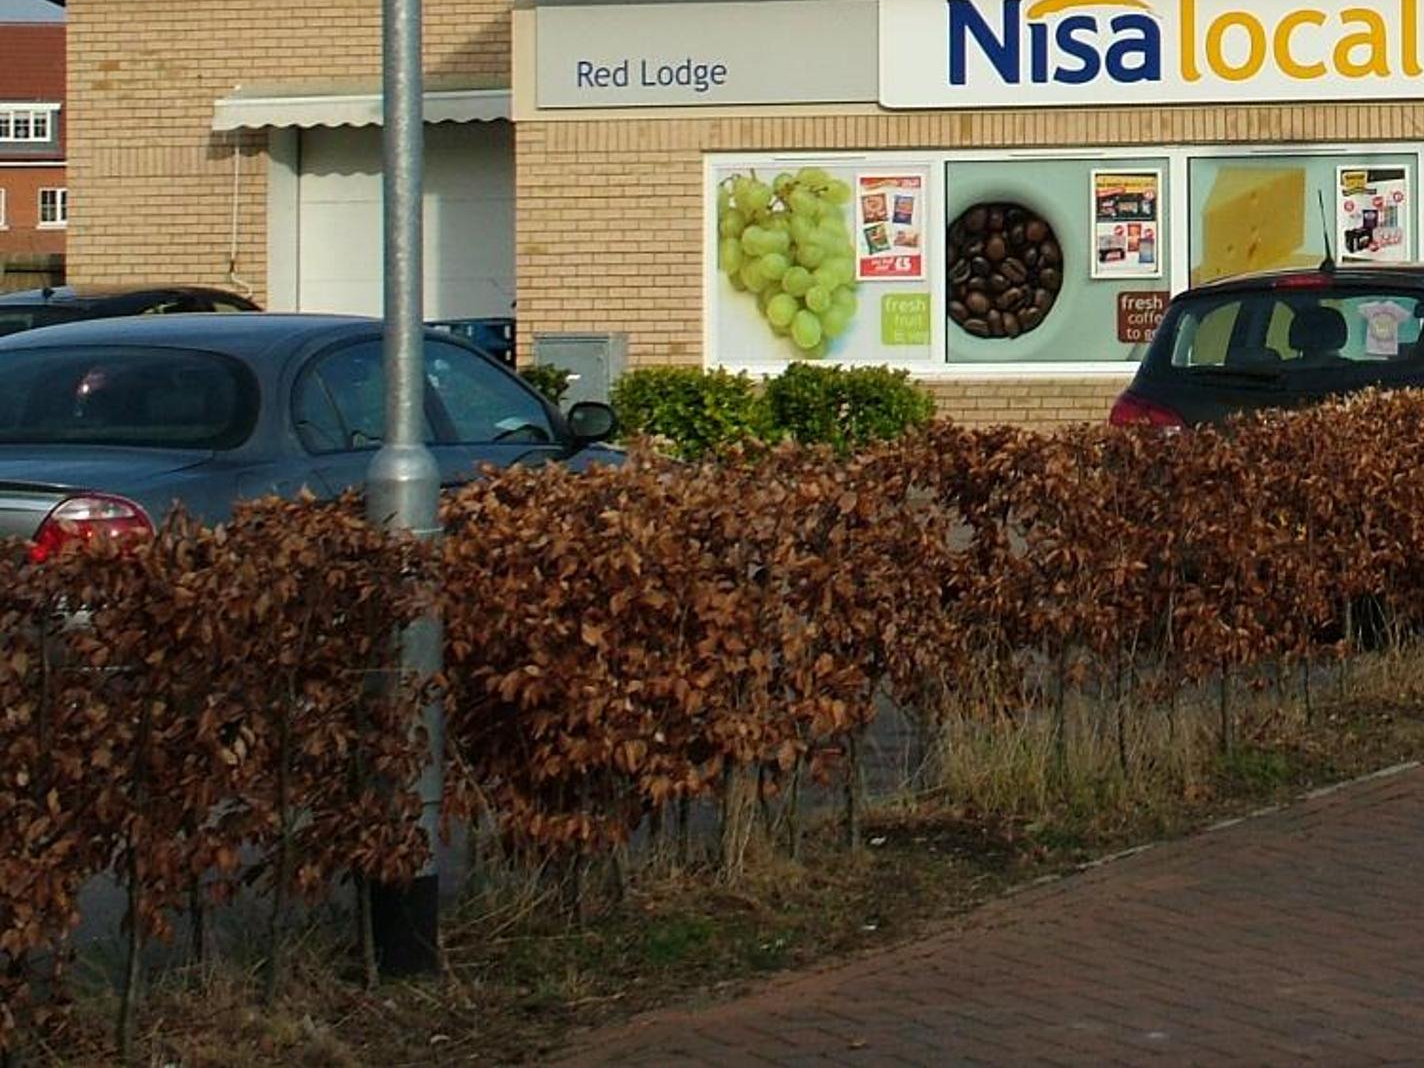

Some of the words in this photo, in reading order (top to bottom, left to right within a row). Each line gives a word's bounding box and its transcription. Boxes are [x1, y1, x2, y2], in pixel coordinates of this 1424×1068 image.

[577, 60, 628, 87] Red
[641, 59, 727, 92] Lodge
[885, 297, 927, 313] fresh
[1121, 294, 1163, 310] fresh
[1127, 311, 1164, 325] coffe
[1126, 328, 1140, 341] to
